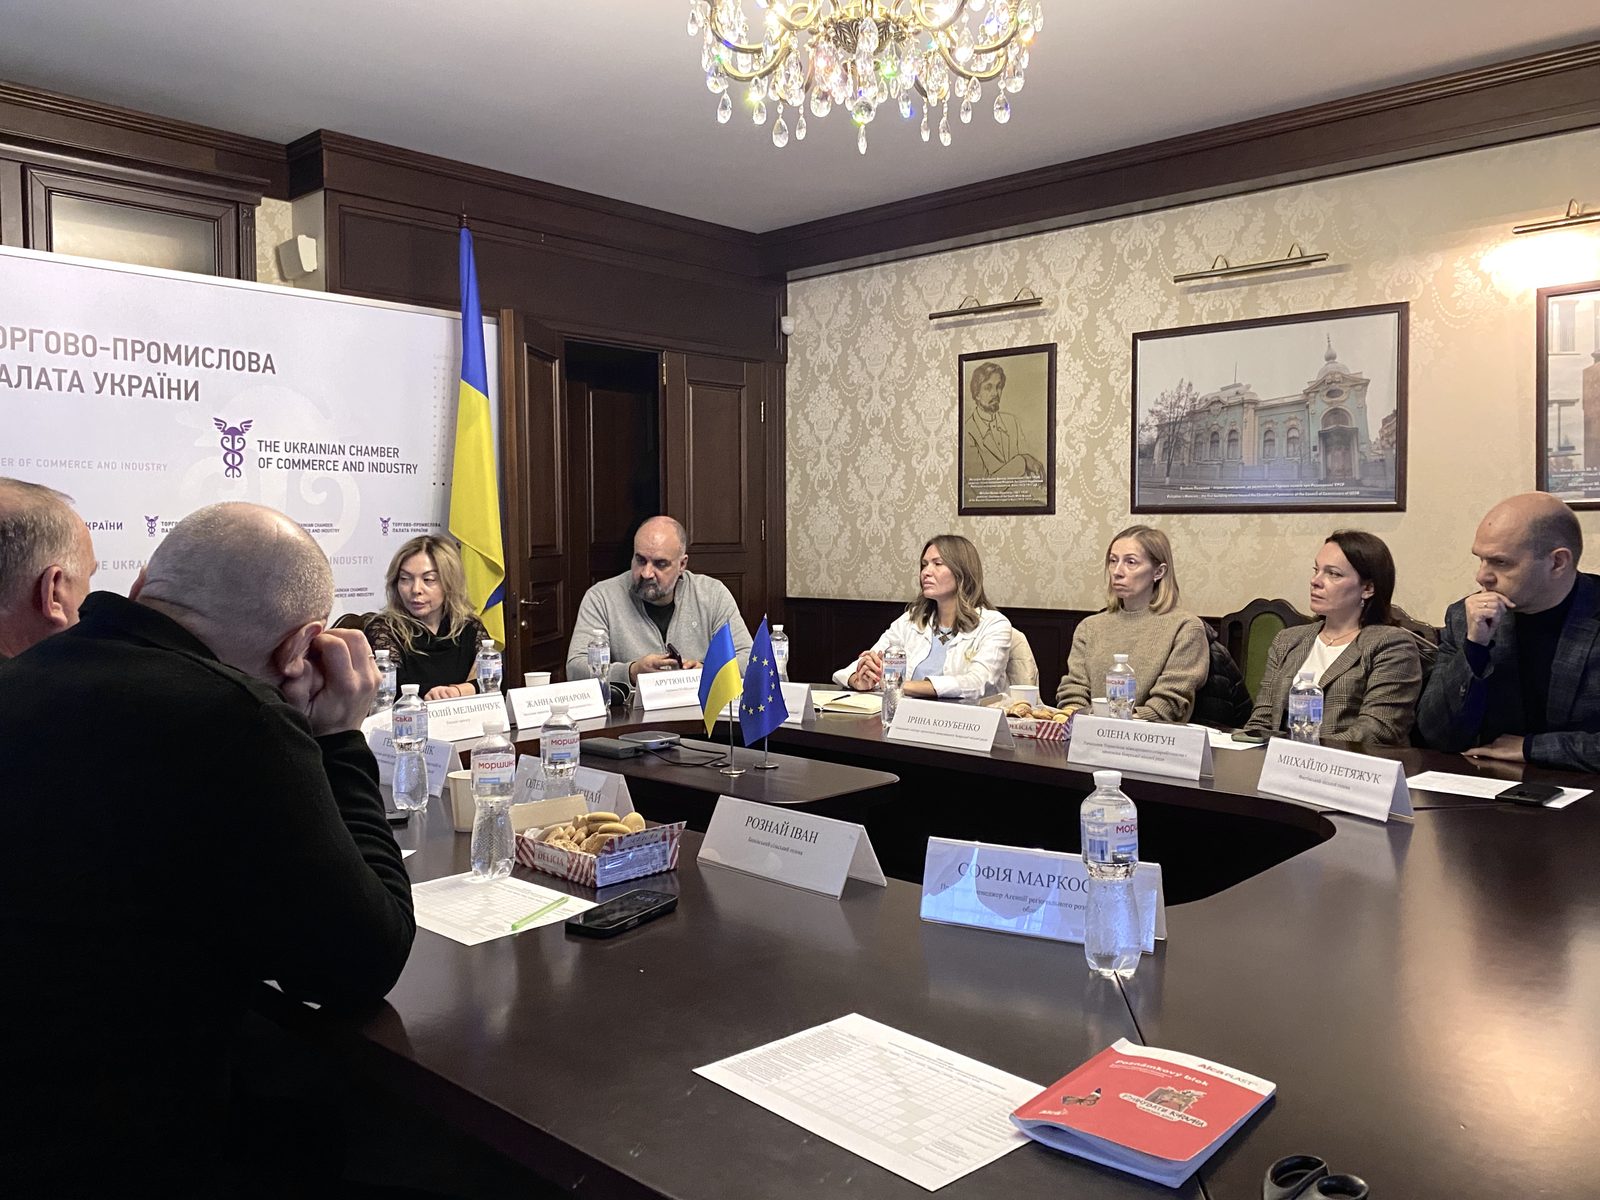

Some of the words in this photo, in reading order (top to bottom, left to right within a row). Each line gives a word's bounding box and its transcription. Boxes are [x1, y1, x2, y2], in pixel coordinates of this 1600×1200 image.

[93, 371, 199, 401] УКРАЇНИ
[257, 440, 280, 453] THE
[284, 441, 346, 456] UKRAINIAN
[349, 445, 400, 459] CHAMBER
[18, 458, 32, 467] OF
[36, 458, 93, 470] COMMERCE
[97, 461, 117, 471] AND
[121, 462, 168, 472] INDUSTRY
[258, 457, 273, 469] OF
[276, 458, 339, 472] COMMERCE
[342, 461, 365, 473] AND
[368, 462, 418, 475] INDUSTRY
[86, 519, 123, 531] КРАЇНИ
[330, 555, 374, 565] INDUSTRY
[453, 701, 502, 716] МЕЛЬНИЧУК
[933, 719, 981, 732] КОЗУБЕНКО
[1096, 728, 1131, 741] ОЛЕНА
[1133, 733, 1176, 746] КОВТУН
[1278, 754, 1328, 773] МИХАЙЛО
[1330, 764, 1382, 785] НЕТЯЖУК
[745, 815, 790, 836] РОЗНАЙ
[790, 826, 819, 844] ІВАН
[957, 862, 1012, 883] СОФІЯ
[1017, 870, 1089, 894] МАРКОС
[1115, 1059, 1182, 1077] Poznámkový
[1183, 1074, 1209, 1087] blok
